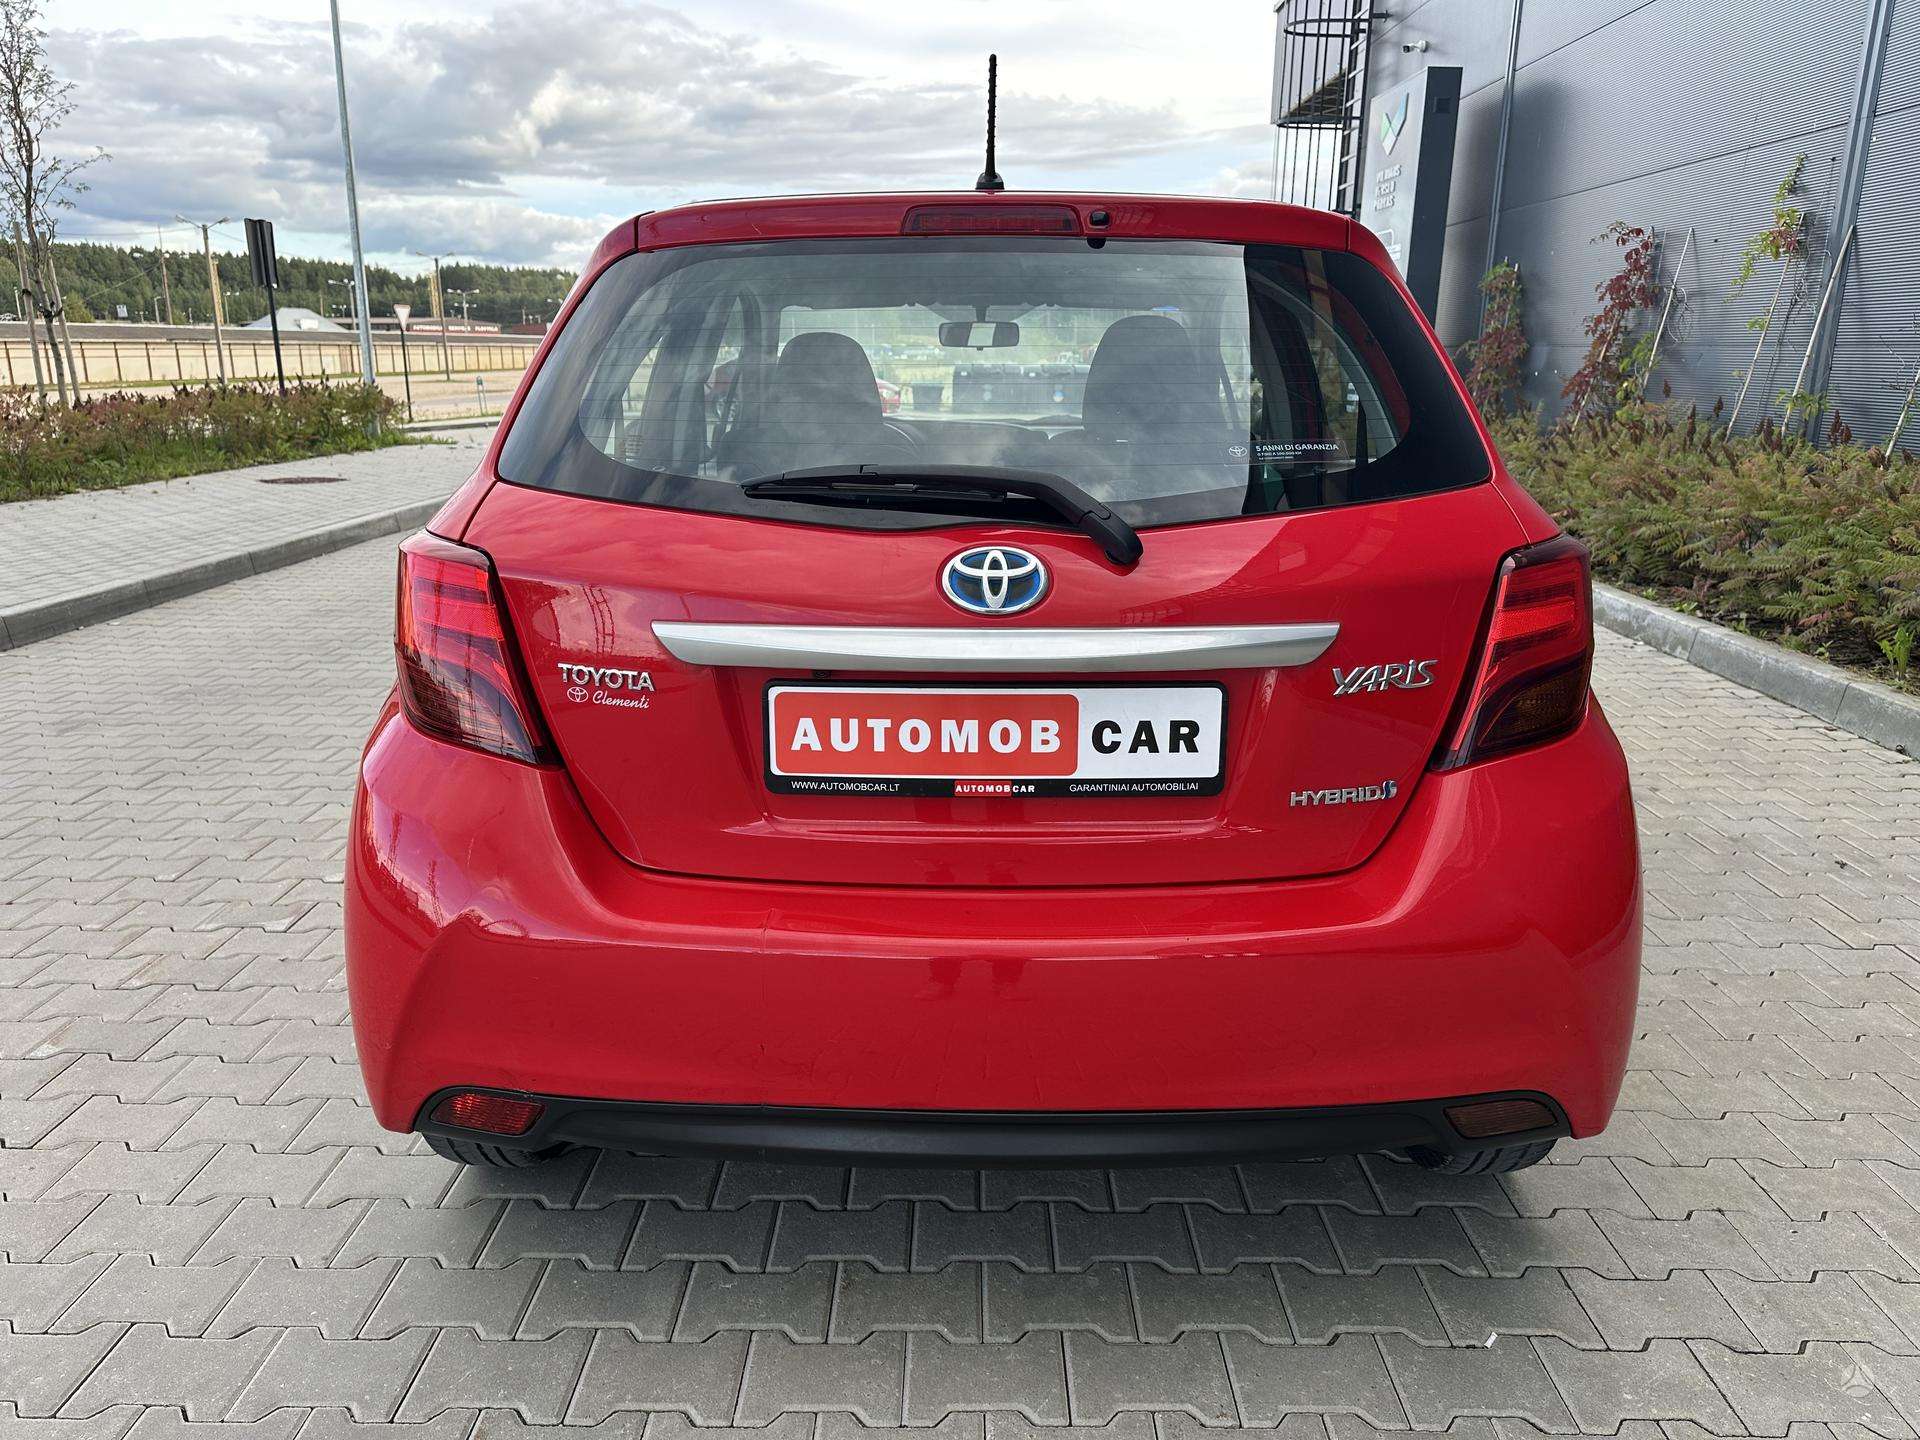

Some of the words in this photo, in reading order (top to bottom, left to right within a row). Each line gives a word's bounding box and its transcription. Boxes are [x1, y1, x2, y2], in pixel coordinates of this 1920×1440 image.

[1262, 444, 1284, 452] ANNI
[1295, 443, 1339, 451] GARANZIA
[557, 663, 655, 692] TOYOTA
[592, 690, 650, 709] Clementi
[790, 717, 1061, 754] AUTOMOB
[1091, 719, 1200, 754] CAR
[791, 781, 900, 793] WWW.AUTOMOBCAR.LT
[1069, 783, 1130, 793] GARANTINIAI
[1131, 782, 1199, 793] AUTOMOBILIAI
